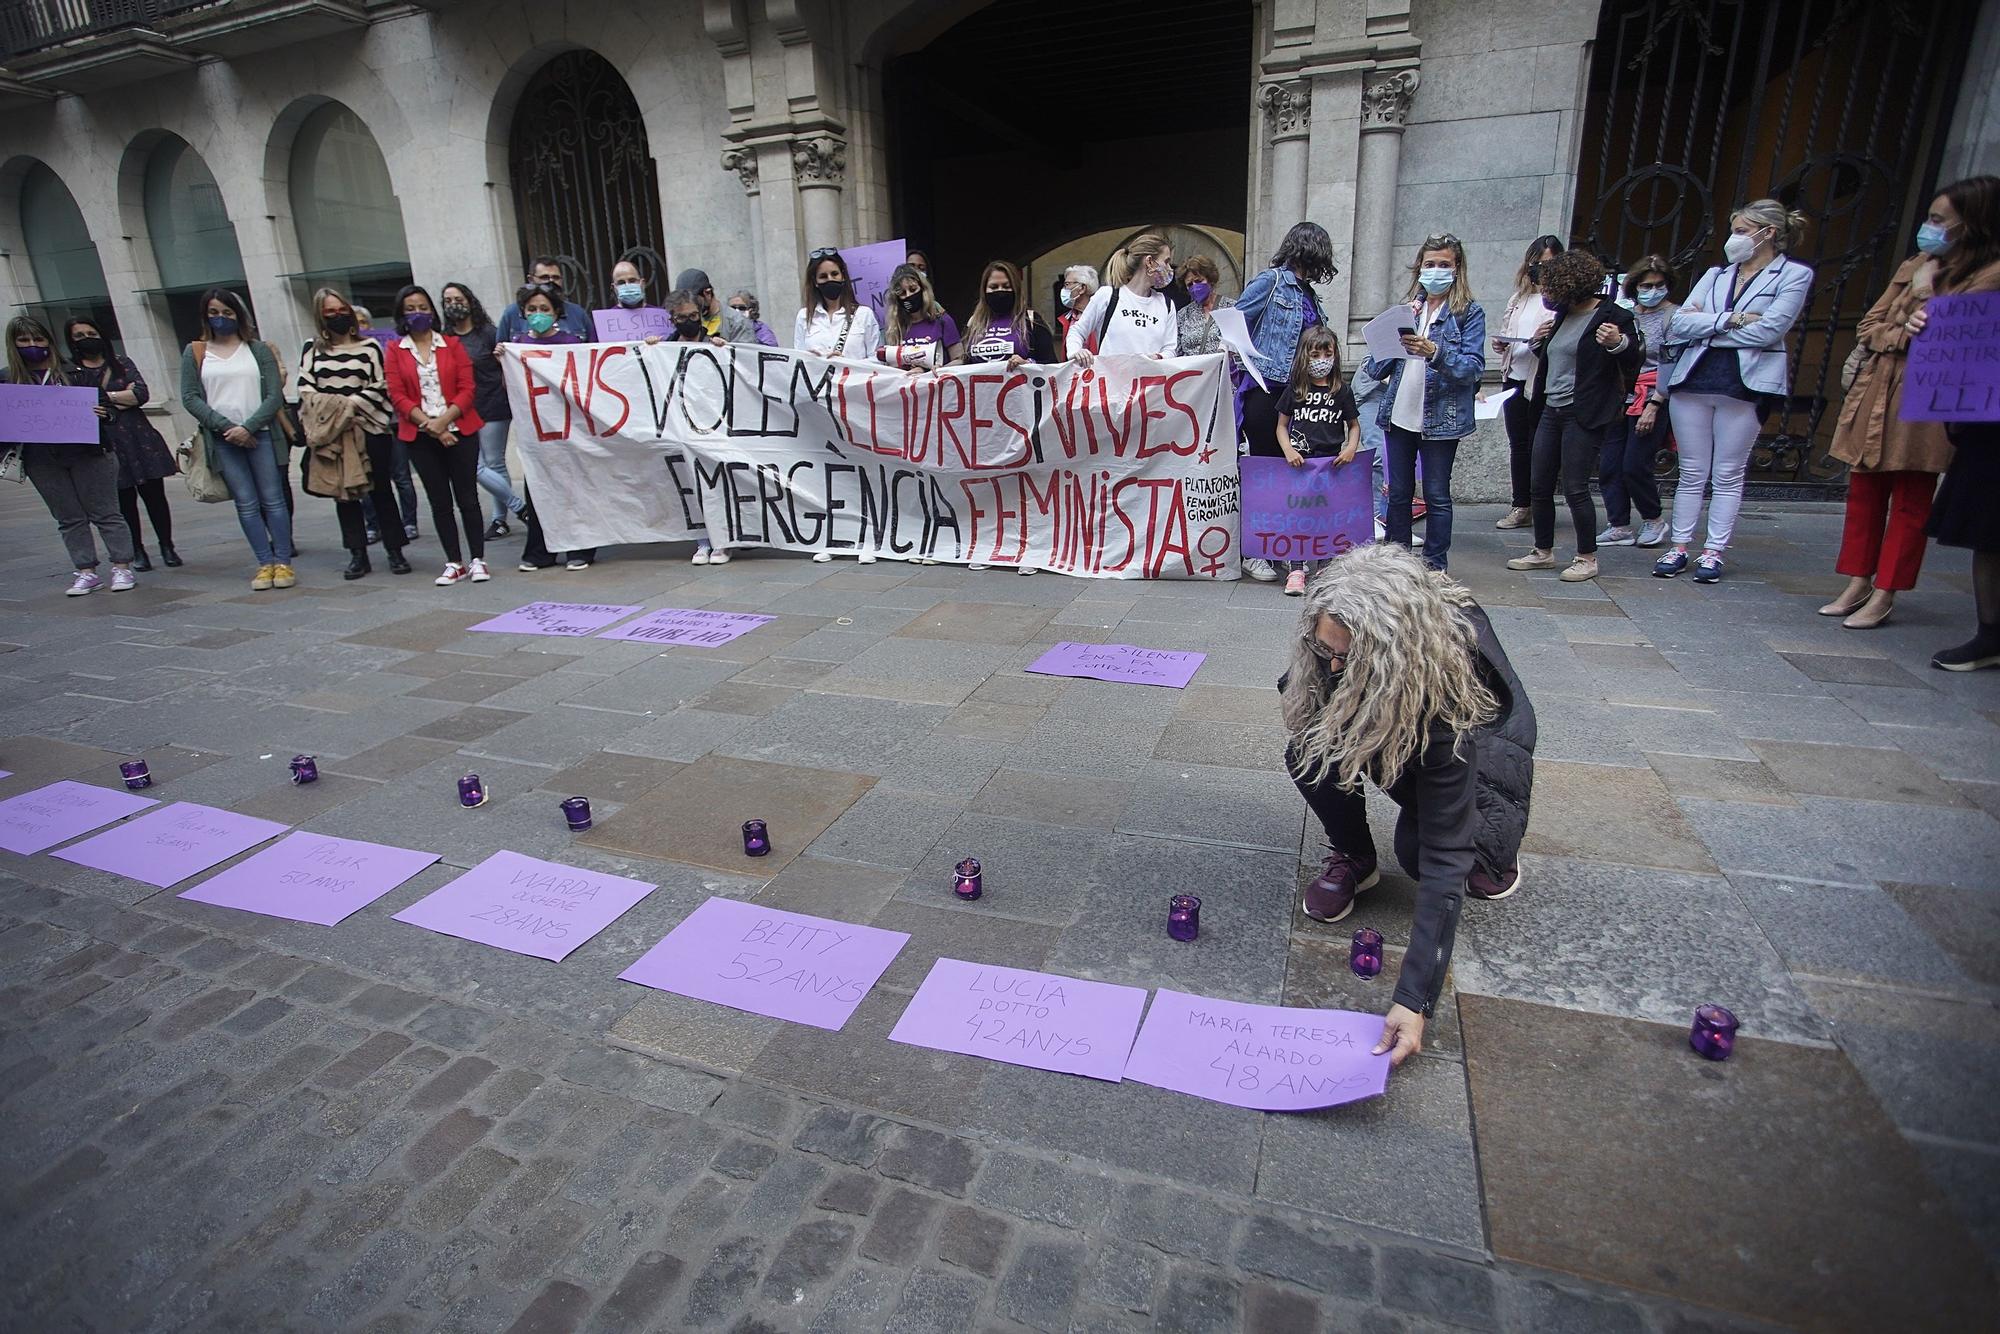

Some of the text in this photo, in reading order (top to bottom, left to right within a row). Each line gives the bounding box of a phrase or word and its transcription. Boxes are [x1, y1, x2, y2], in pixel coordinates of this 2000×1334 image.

[607, 312, 670, 333] EL SILEN
[1135, 319, 1147, 328] 61
[1914, 370, 1977, 387] VULL
[520, 346, 632, 441] ENS
[633, 345, 846, 441] VOLEM
[838, 367, 1032, 470] LLIURES
[1305, 392, 1335, 406] 99%
[1927, 386, 2000, 412] LLI
[1293, 407, 1343, 424] ANGRY!
[1185, 474, 1241, 495] PLATAFORMA
[1254, 532, 1353, 556] TOTES
[1118, 645, 1192, 662] SILENCI
[1130, 658, 1154, 667] FA
[509, 869, 603, 902] WARDA
[740, 919, 853, 958] BETTY
[978, 997, 1050, 1019] DOTTO
[1270, 1024, 1356, 1049] TERESA
[1224, 1039, 1324, 1067] ALARDO
